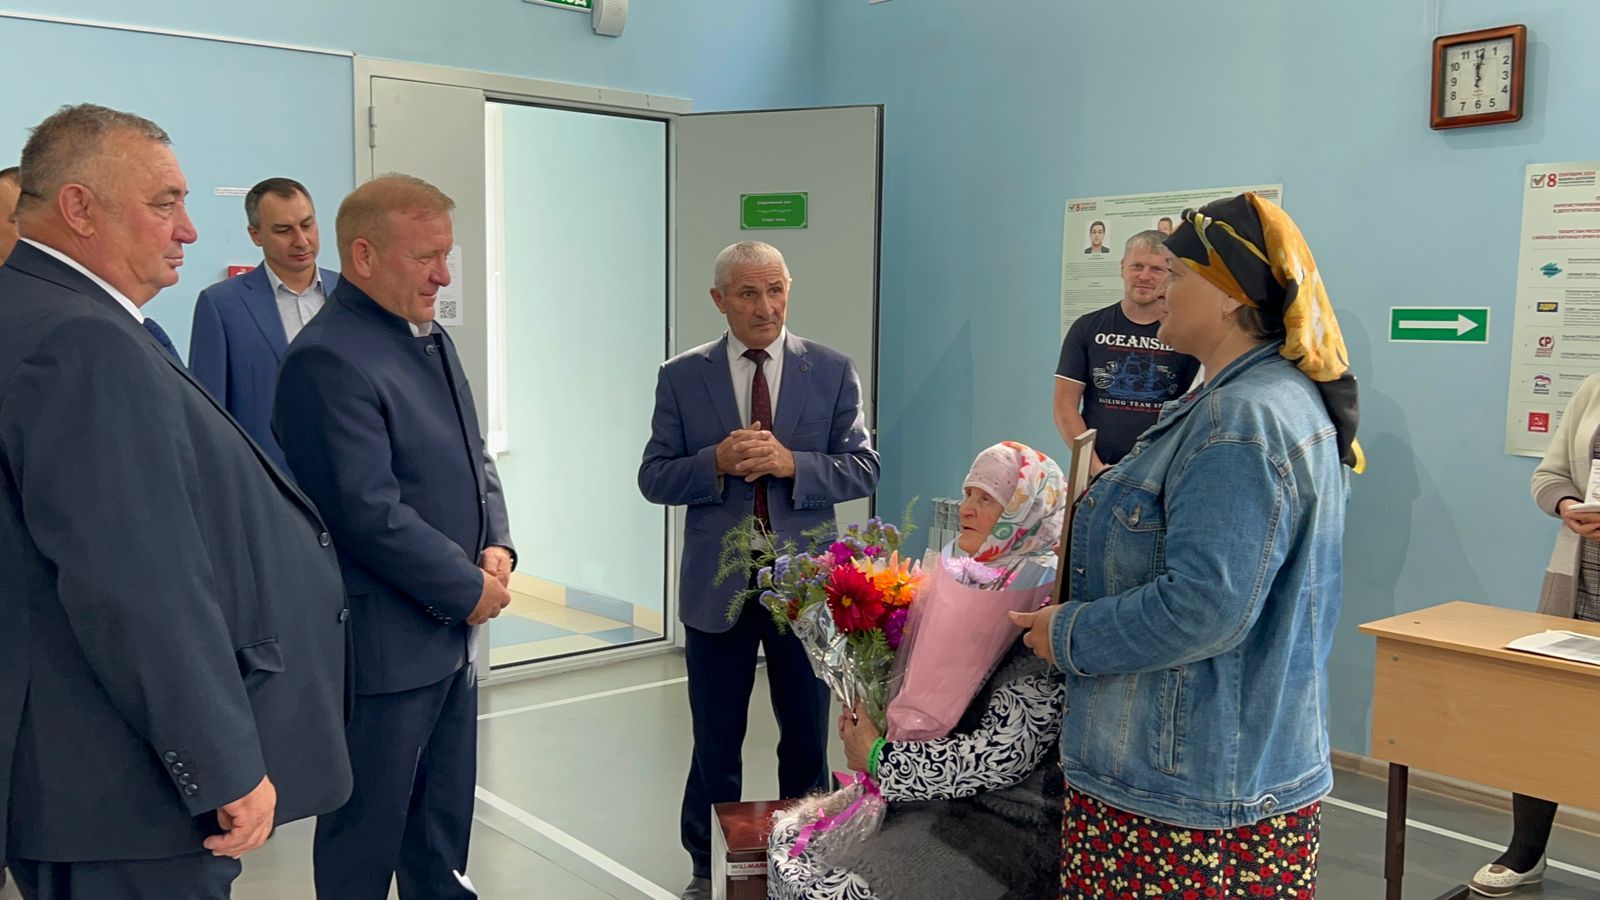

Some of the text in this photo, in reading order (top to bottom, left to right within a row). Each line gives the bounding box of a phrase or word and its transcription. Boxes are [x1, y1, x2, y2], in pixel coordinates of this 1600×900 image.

[1461, 50, 1471, 60] 11
[1492, 46, 1498, 56] 1
[1502, 55, 1510, 65] 2
[1450, 62, 1460, 72] 10
[1502, 71, 1509, 80] 3
[1450, 77, 1457, 87] 9
[1501, 85, 1508, 94] 4
[1450, 91, 1457, 101] 8
[1460, 101, 1467, 112] 7
[1474, 100, 1482, 110] 6
[1488, 98, 1496, 108] 5
[1547, 173, 1557, 188] 8
[1129, 400, 1151, 409] TEAM
